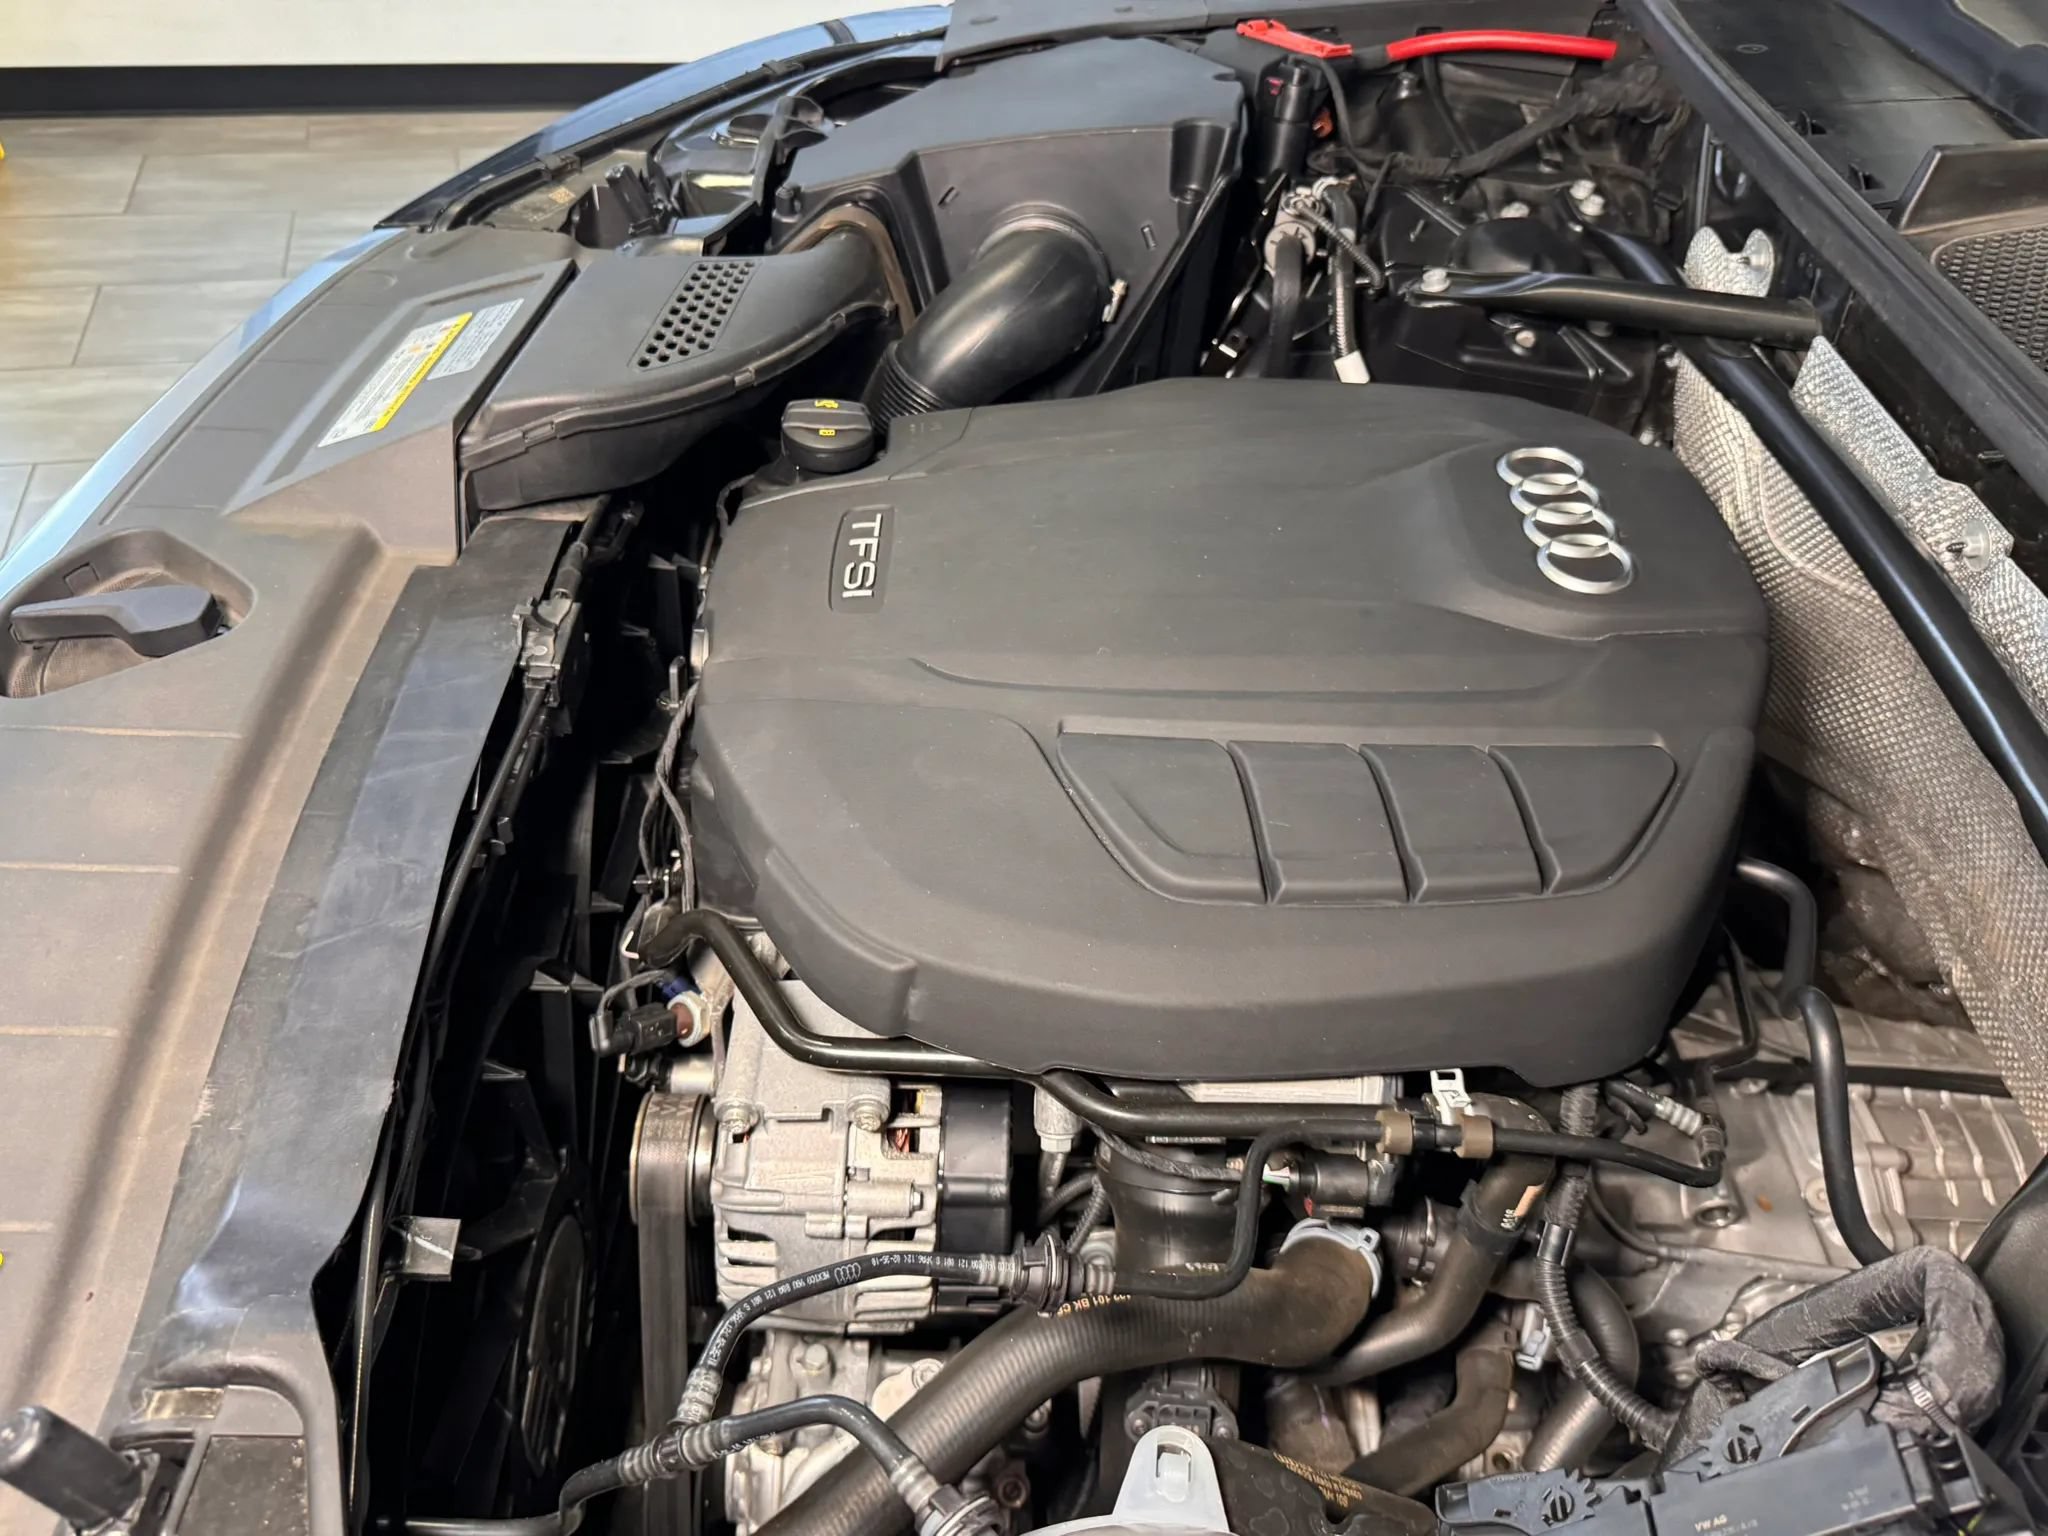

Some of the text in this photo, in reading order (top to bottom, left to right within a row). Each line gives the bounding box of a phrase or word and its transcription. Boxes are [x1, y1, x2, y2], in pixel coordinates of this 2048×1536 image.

[842, 513, 882, 598] TFSI
[764, 1288, 777, 1300] 121
[1072, 1298, 1090, 1313] BK
[1694, 1520, 1711, 1532] VW
